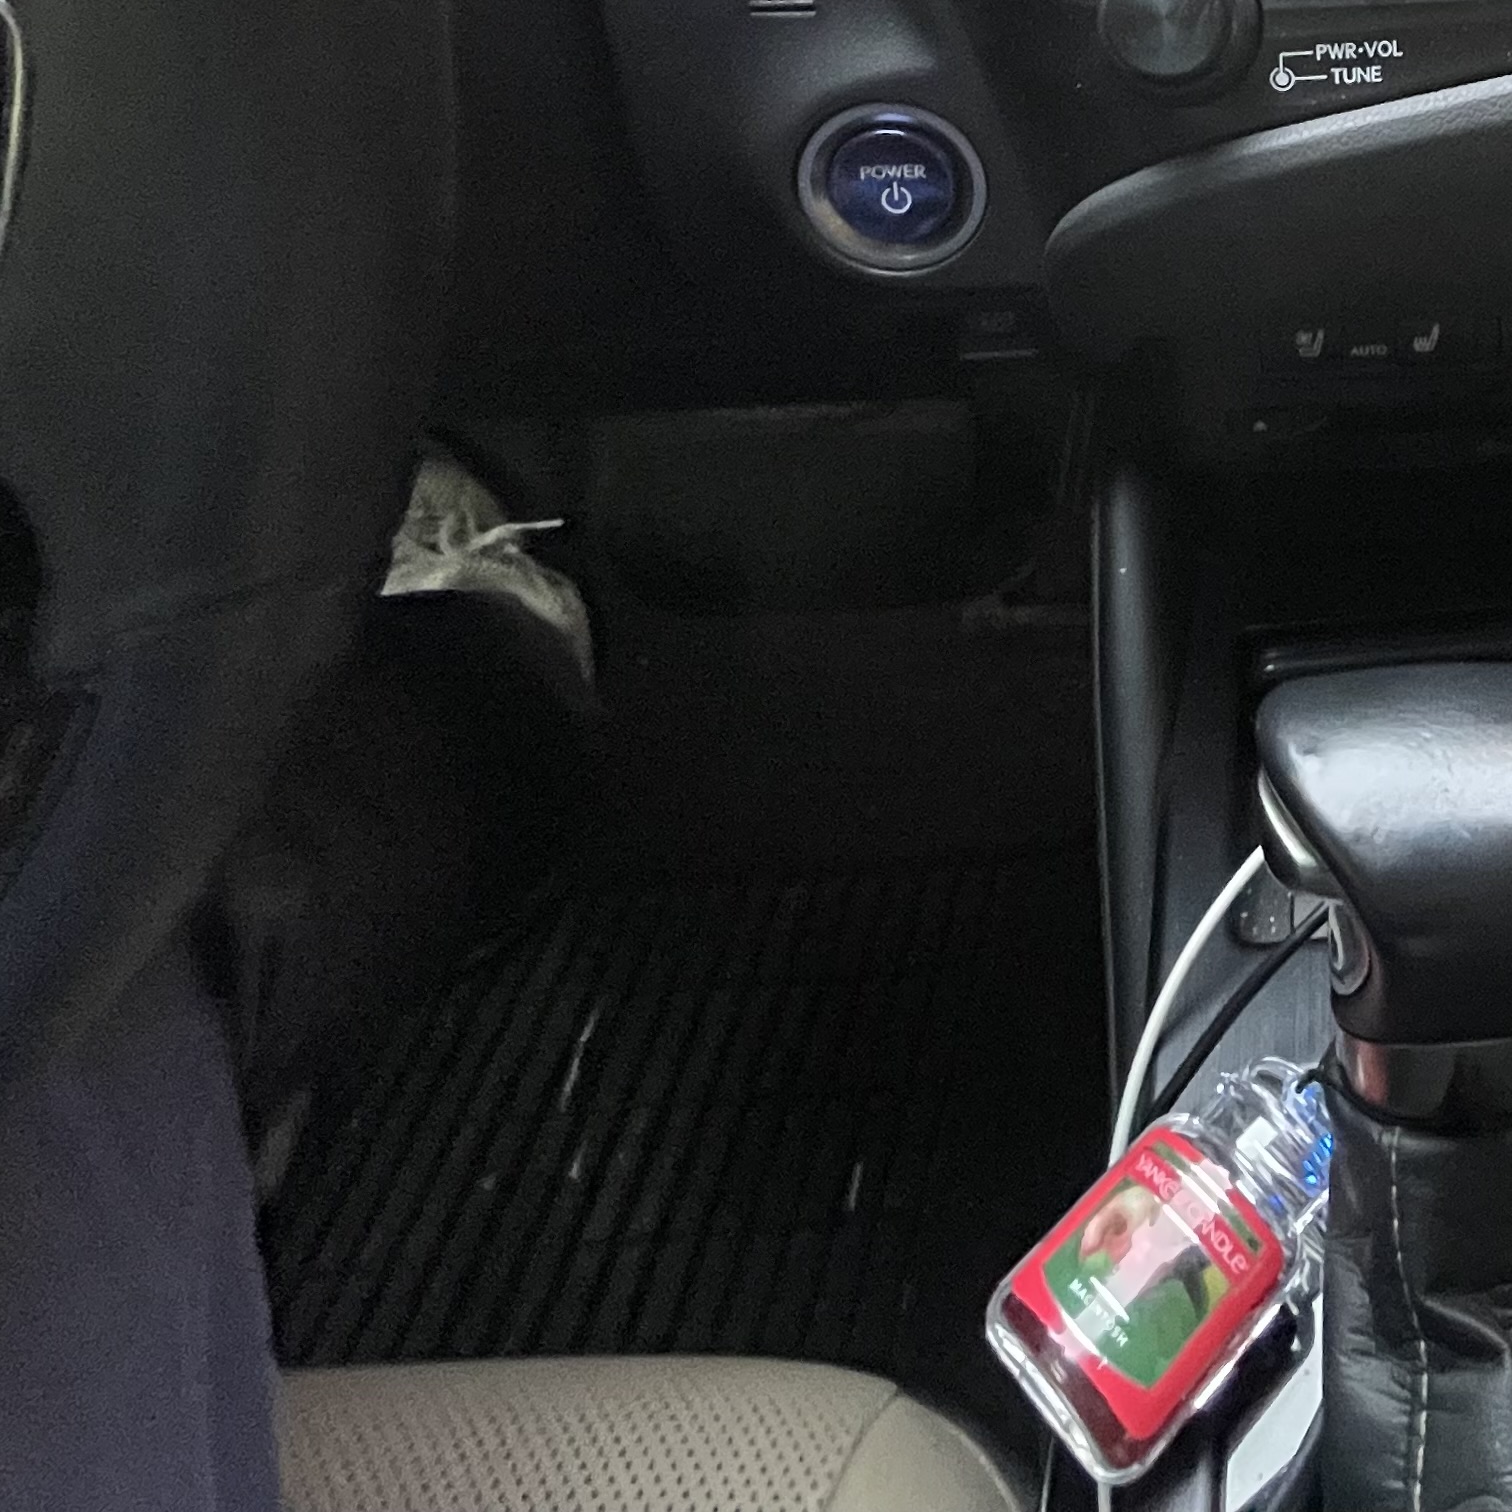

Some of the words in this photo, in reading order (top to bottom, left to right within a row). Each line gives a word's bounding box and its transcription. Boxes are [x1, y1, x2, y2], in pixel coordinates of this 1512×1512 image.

[1330, 66, 1382, 85] TUNE
[860, 163, 926, 180] POWER
[1351, 344, 1387, 357] AUTO
